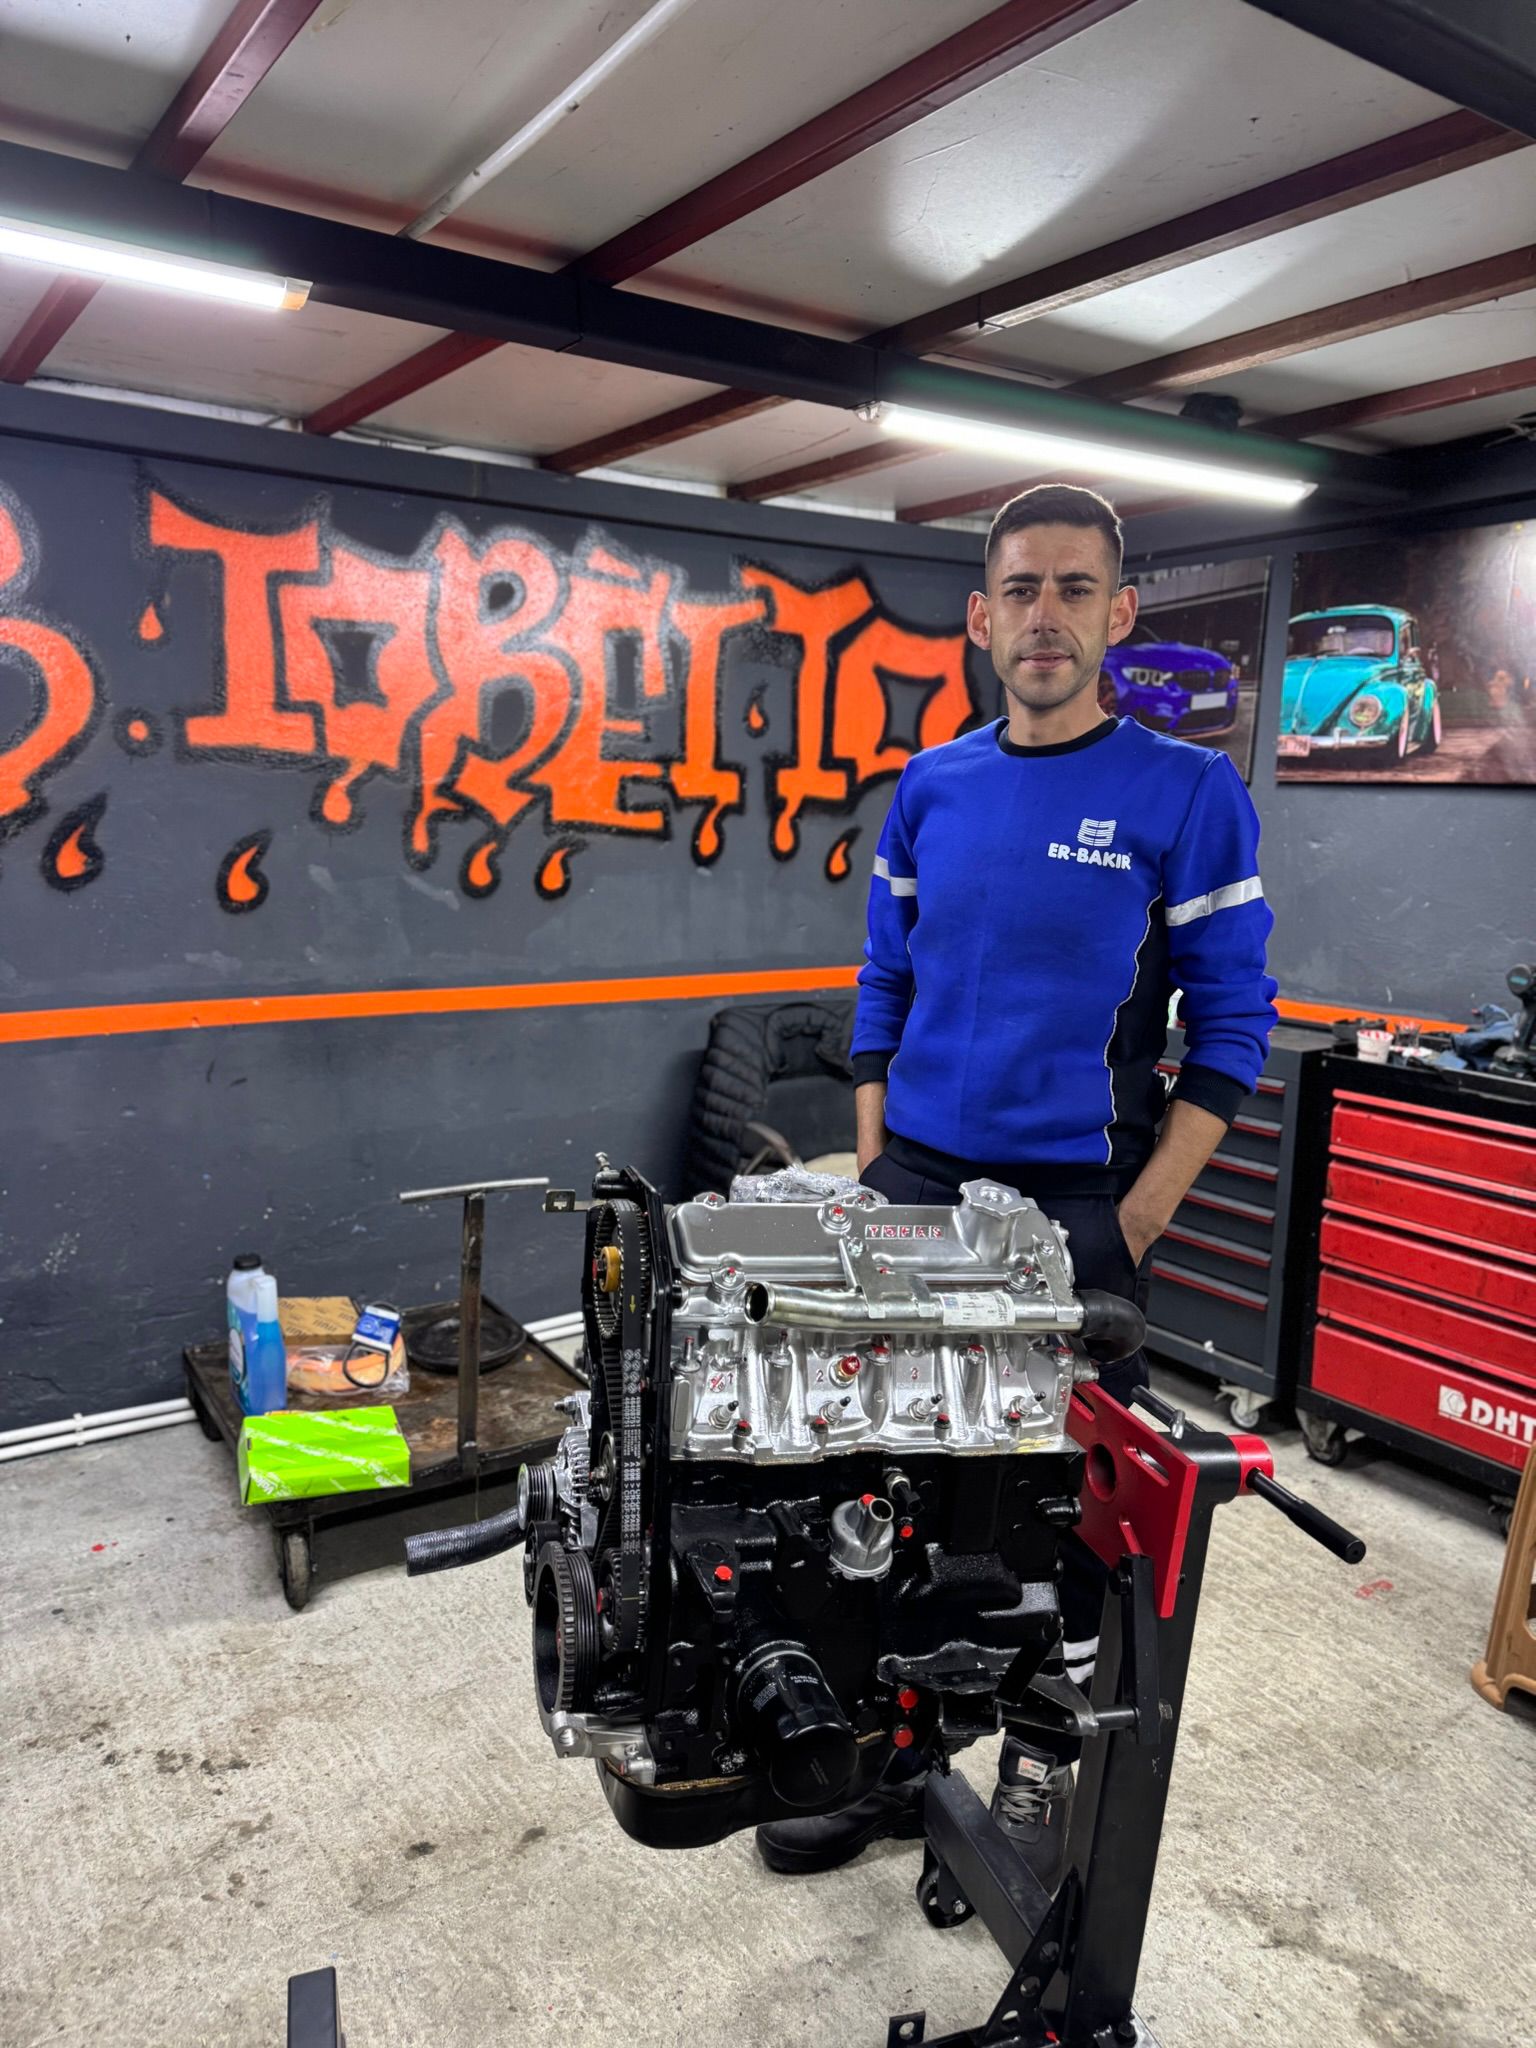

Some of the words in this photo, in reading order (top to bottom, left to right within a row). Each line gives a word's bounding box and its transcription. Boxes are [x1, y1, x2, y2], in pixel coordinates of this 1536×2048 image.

[1048, 842, 1132, 870] ER-BAKIR
[816, 1369, 824, 1382] 2
[911, 1367, 919, 1380] 3
[1002, 1365, 1011, 1377] 4
